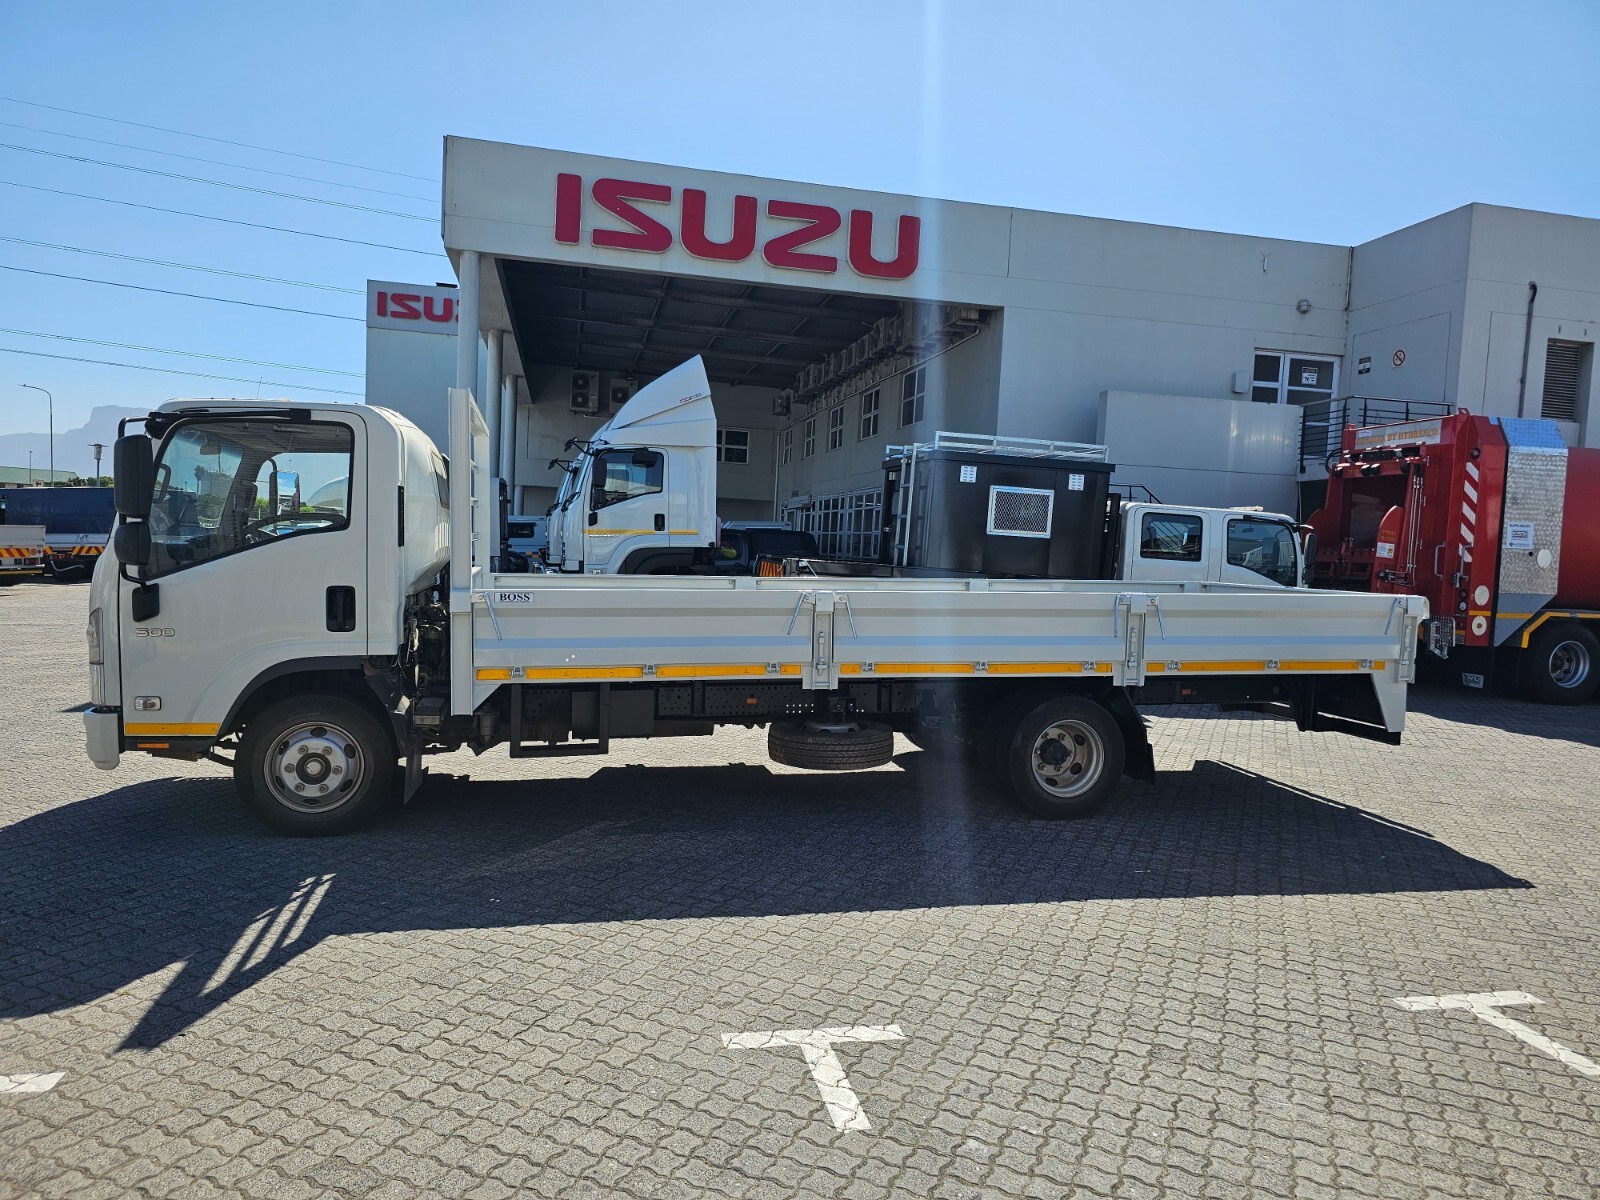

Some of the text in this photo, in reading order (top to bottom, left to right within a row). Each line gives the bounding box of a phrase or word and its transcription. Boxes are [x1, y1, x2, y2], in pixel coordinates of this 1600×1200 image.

[555, 172, 921, 279] ISUZU
[377, 291, 459, 323] ISU
[500, 593, 530, 601] BOSS
[136, 627, 176, 638] 500
